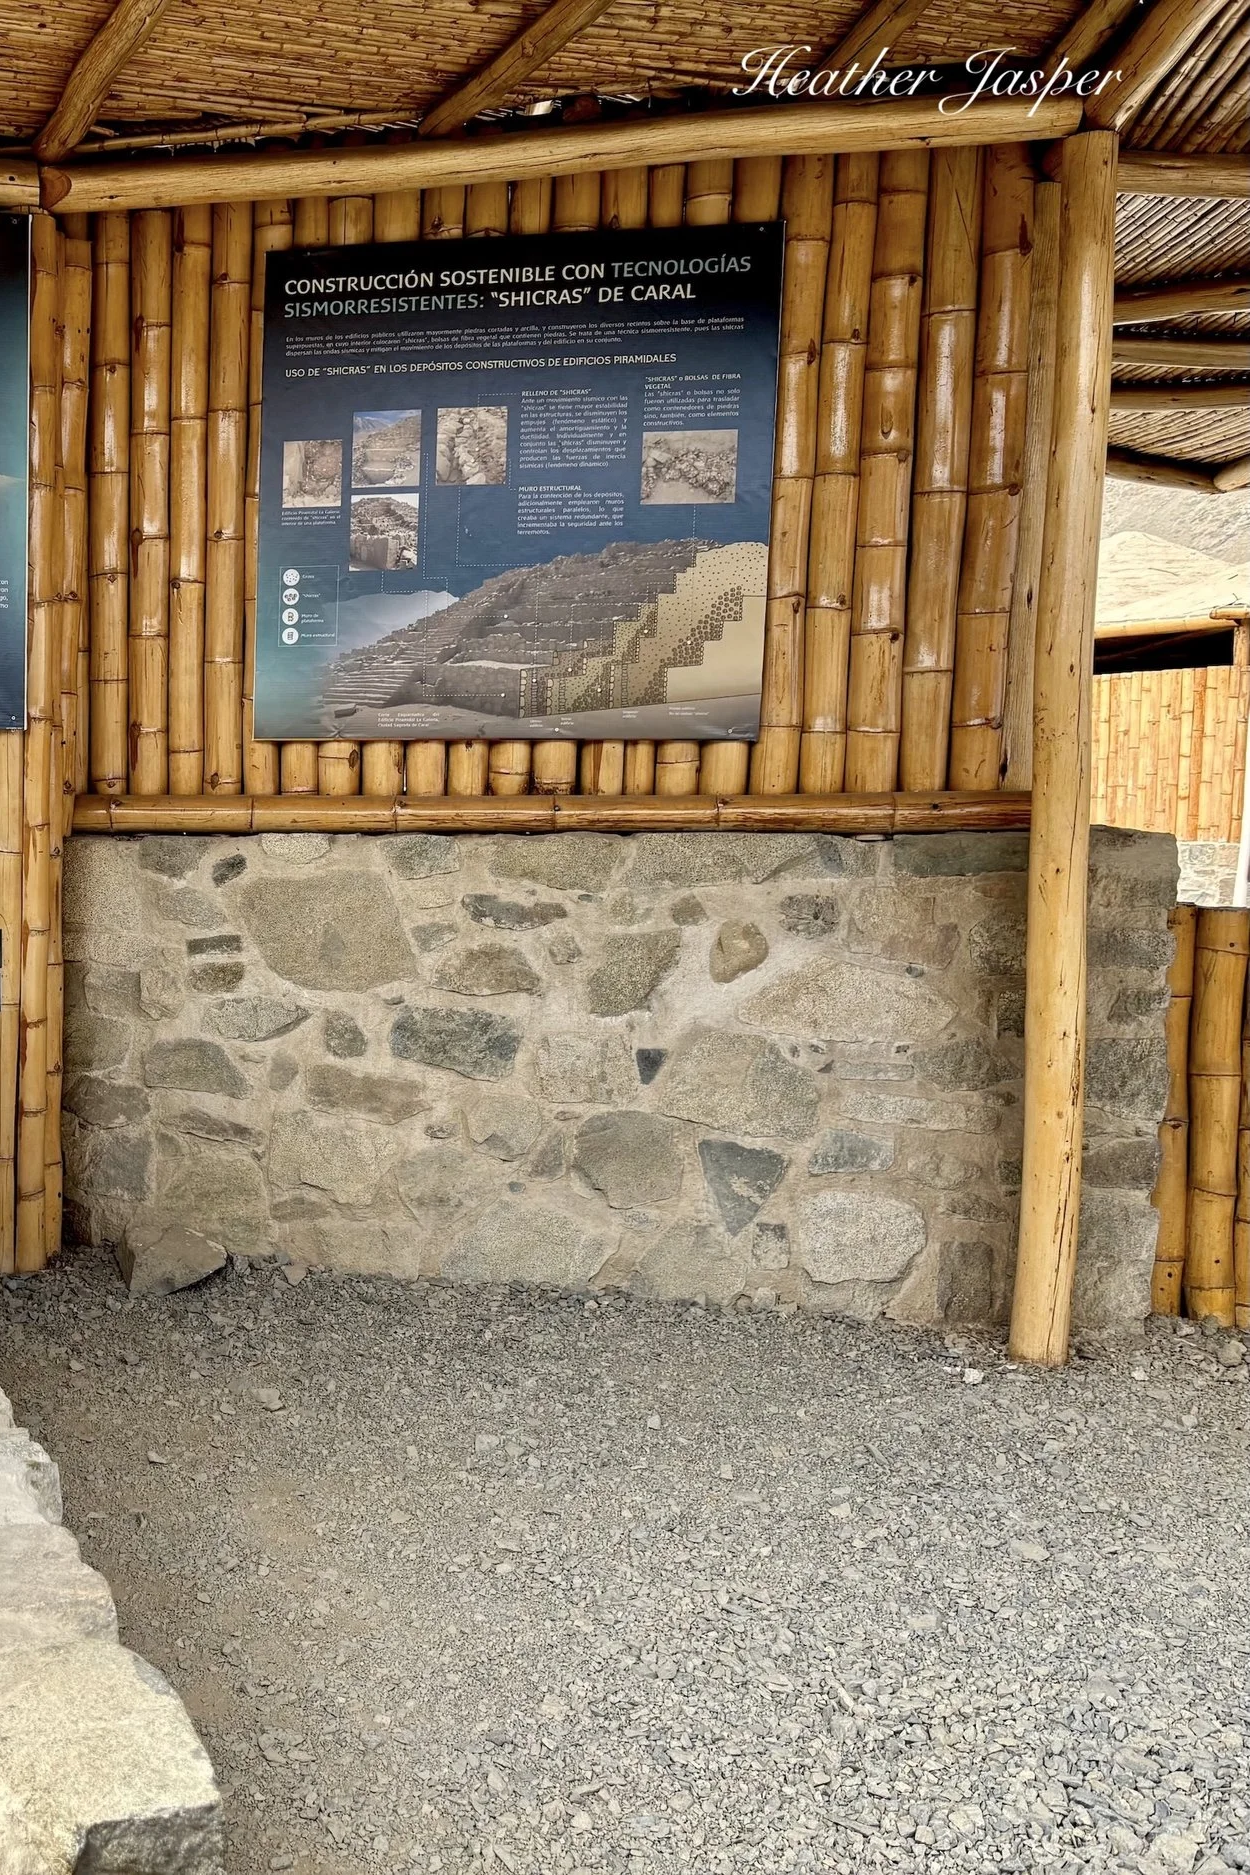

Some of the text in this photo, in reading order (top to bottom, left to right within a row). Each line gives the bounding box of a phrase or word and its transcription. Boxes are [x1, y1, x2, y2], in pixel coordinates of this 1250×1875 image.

[285, 256, 751, 294] CONSTRUCCIÓN SOSTENIBLE CON TECNOLOGÍAS
[285, 294, 484, 317] SISMORRESISTENTES:
[599, 287, 624, 302] DE
[631, 284, 696, 300] CARAL
[286, 369, 305, 377] USO
[308, 368, 320, 376] DE
[374, 365, 386, 373] EN
[390, 364, 407, 373] LOS
[410, 362, 463, 372] DEPÓSITOS
[466, 359, 545, 369] CONSTRUCTIVOS
[548, 358, 561, 366] DE
[563, 356, 611, 366] EDIFICIOS
[614, 354, 676, 364] PIRAMIDALES
